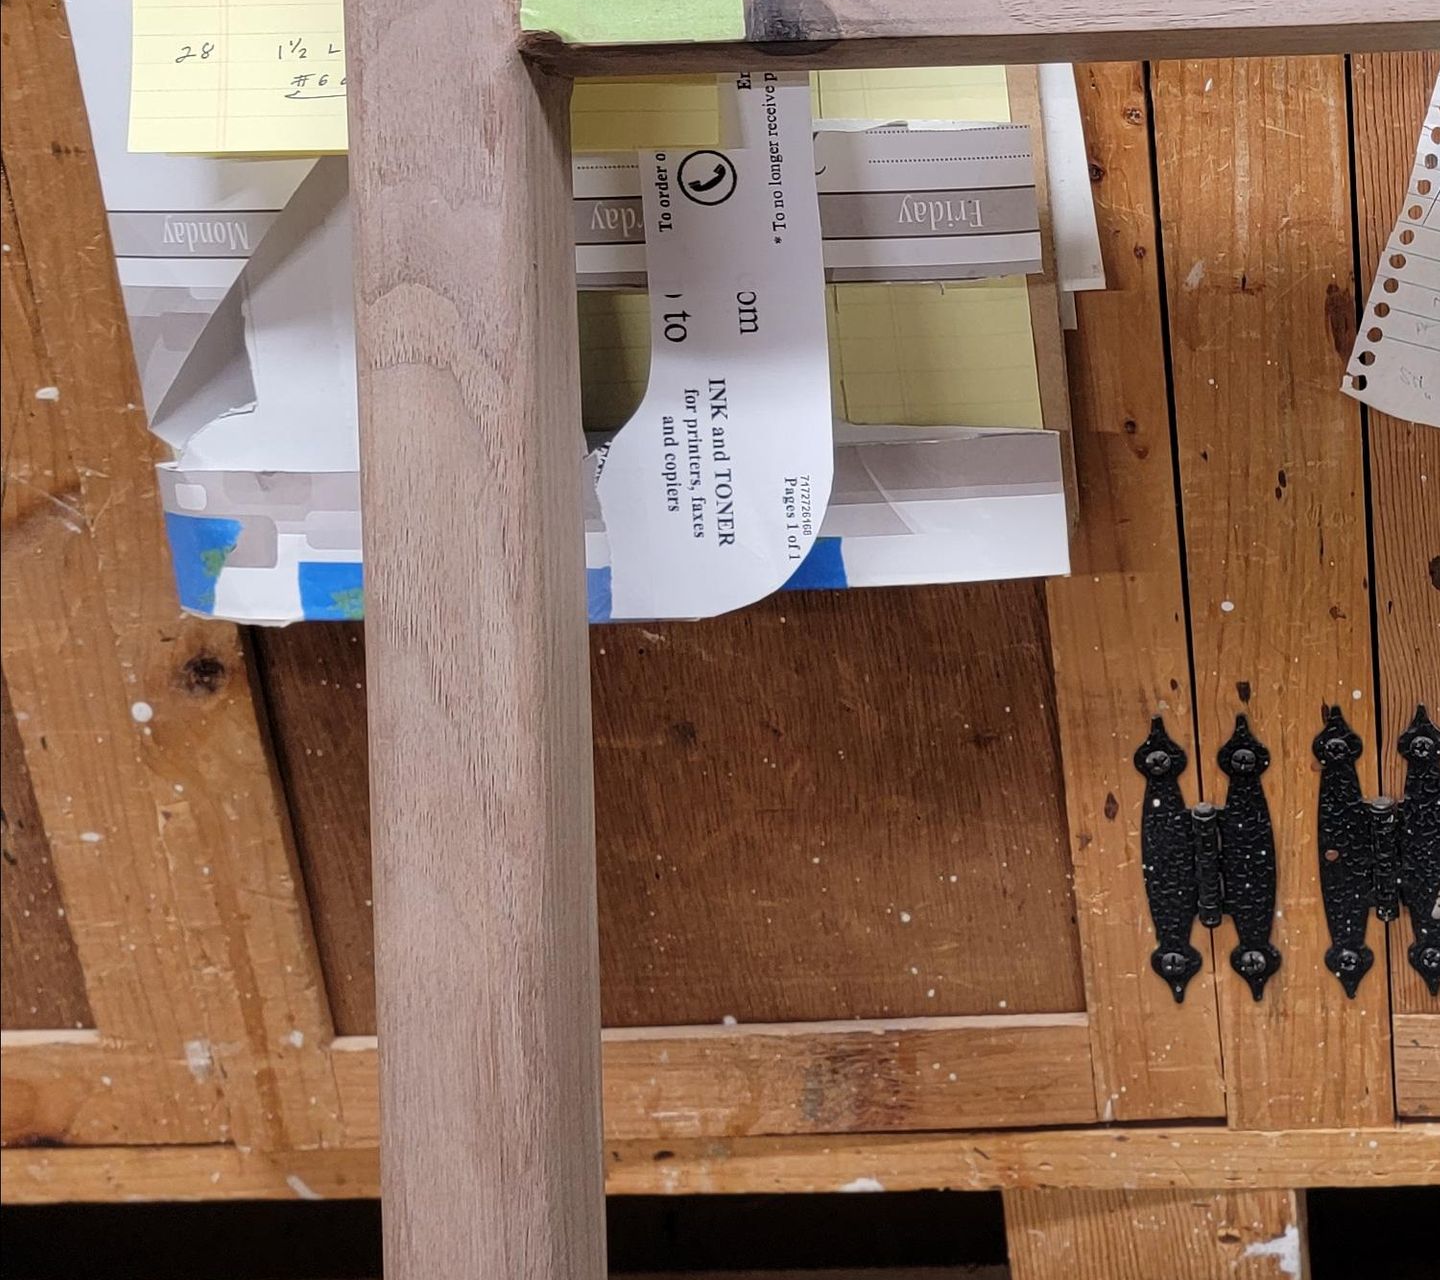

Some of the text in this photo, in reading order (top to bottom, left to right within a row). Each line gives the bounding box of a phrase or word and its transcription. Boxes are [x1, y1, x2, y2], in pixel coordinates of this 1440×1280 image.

[175, 43, 215, 64] 28
[761, 85, 778, 138] receive
[768, 140, 782, 186] longer
[655, 165, 670, 209] order
[772, 189, 785, 209] no
[658, 213, 673, 232] To
[772, 212, 786, 231] To
[898, 194, 985, 231] Friday
[163, 214, 251, 253] Monday
[663, 310, 692, 343] to
[661, 415, 682, 513] and copiers
[682, 388, 707, 539] for printers, faxes
[708, 377, 736, 547] INK and TONER
[782, 477, 798, 518] Pages
[788, 535, 801, 554] of
